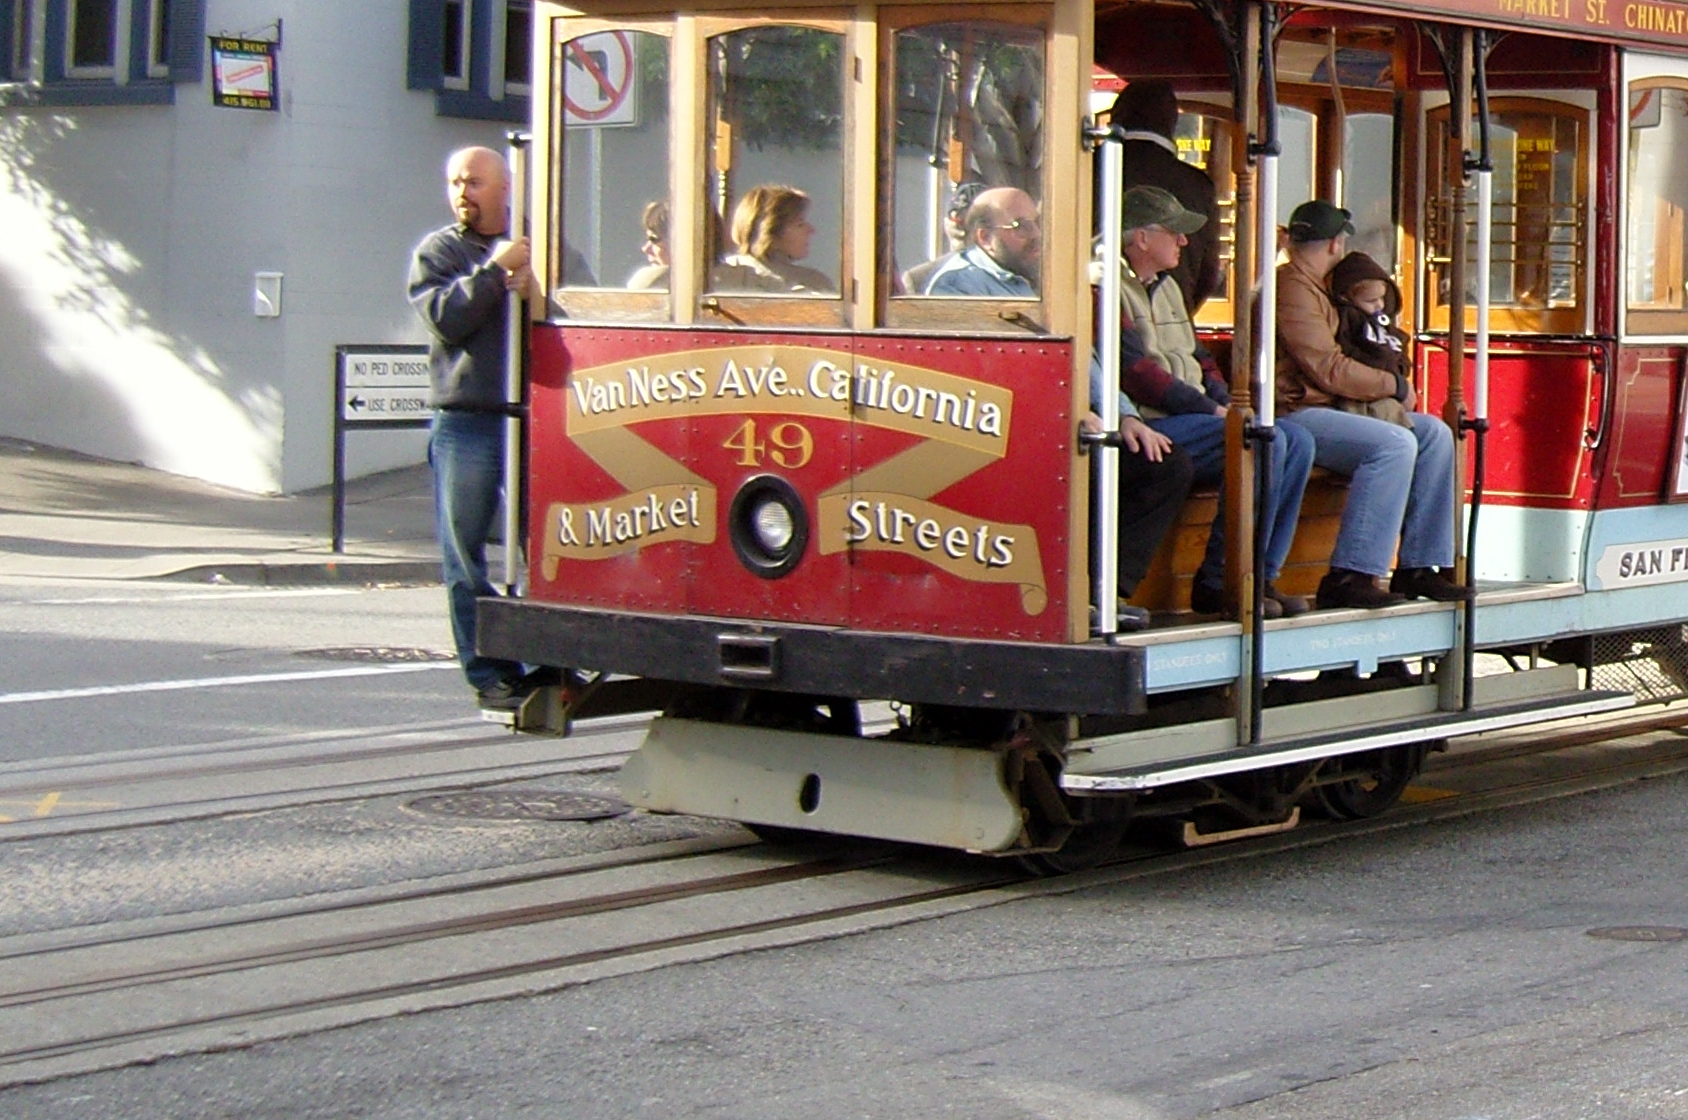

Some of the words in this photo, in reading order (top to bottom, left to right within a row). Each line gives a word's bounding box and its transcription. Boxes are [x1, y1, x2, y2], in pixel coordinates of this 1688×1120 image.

[219, 40, 239, 51] FOR
[243, 42, 268, 53] RENT
[354, 362, 367, 376] NO
[371, 362, 389, 375] PED
[393, 362, 429, 376] CROSSIN
[368, 398, 386, 411] USE
[390, 398, 429, 411] CROSSW
[572, 378, 626, 416] Van
[627, 367, 707, 407] Ness
[808, 359, 1003, 438] California
[722, 417, 814, 469] 49
[557, 508, 580, 546] &
[586, 490, 701, 547] Market
[848, 499, 1016, 568] Streets
[1619, 548, 1663, 579] SAN
